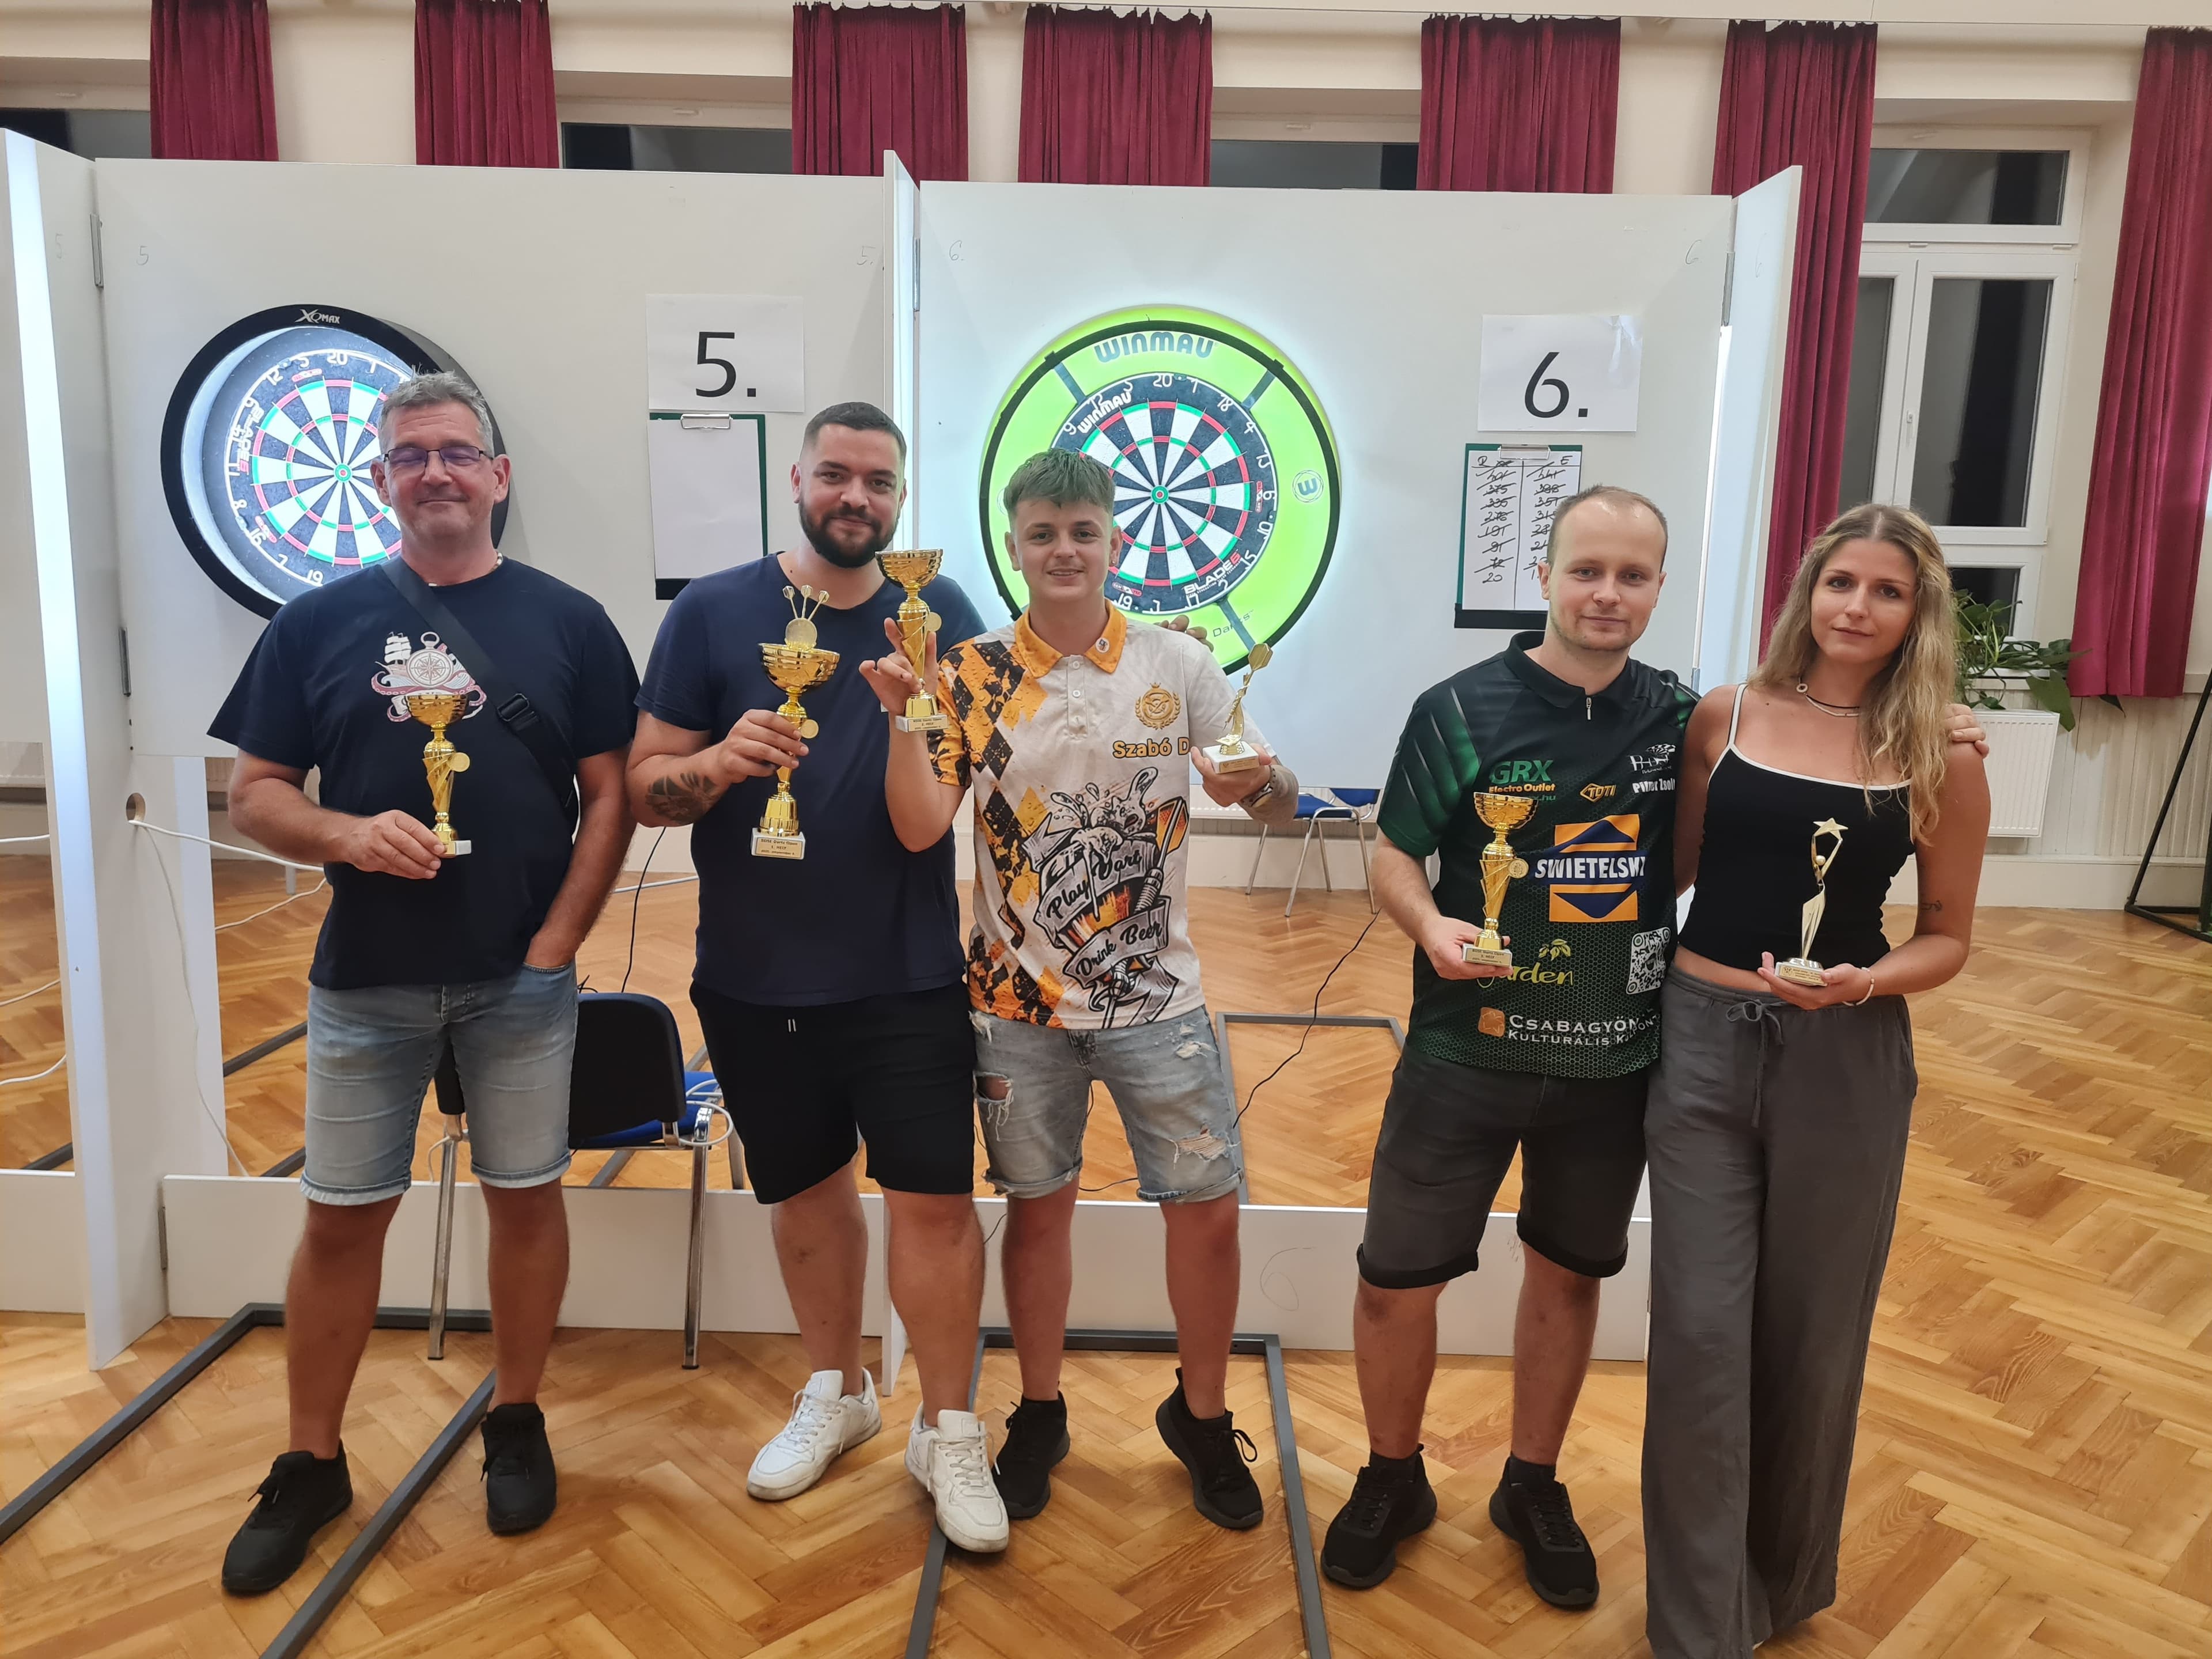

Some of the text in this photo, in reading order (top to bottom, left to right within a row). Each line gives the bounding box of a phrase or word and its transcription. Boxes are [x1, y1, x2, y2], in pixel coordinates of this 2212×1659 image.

[136, 245, 149, 266] 5
[1094, 331, 1214, 363] WINMAU
[327, 351, 349, 366] 20
[695, 331, 756, 397] 5.
[1153, 374, 1173, 388] 20
[1524, 351, 1588, 418] 6.
[1217, 393, 1234, 412] 18
[1063, 422, 1076, 435] 9
[1244, 421, 1256, 434] 4
[1560, 456, 1573, 465] E
[1184, 552, 1241, 594] BLADE6
[1482, 573, 1503, 584] 20
[1112, 737, 1172, 759] Szabó
[1489, 760, 1554, 784] GRX
[1488, 782, 1556, 793] Electro Outlet
[1046, 880, 1089, 919] Play
[1075, 921, 1162, 976] Drink Beer
